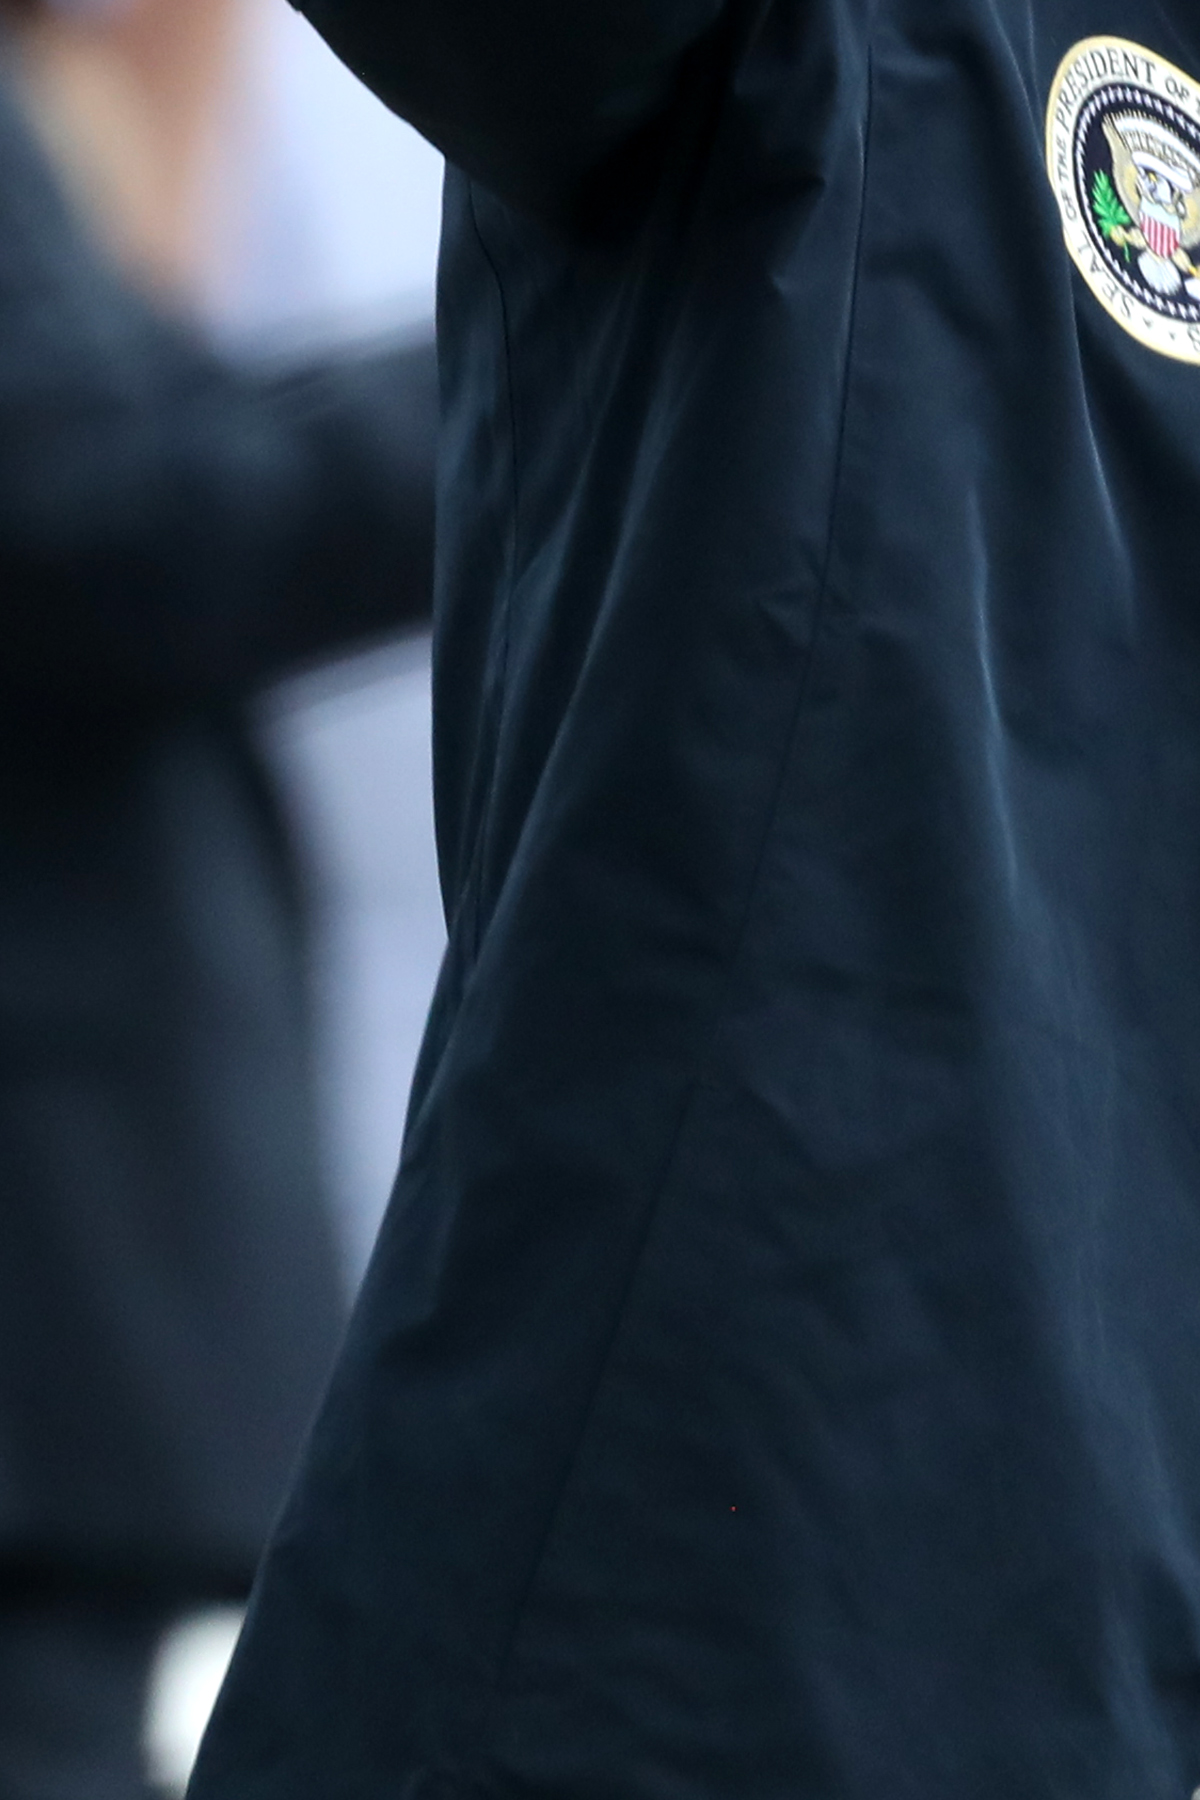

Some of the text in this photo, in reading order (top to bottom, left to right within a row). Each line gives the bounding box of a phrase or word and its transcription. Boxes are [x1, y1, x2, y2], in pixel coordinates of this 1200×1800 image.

[1056, 48, 1156, 129] PRESIDENT
[1056, 138, 1069, 181] THE
[1077, 237, 1133, 318] SEAL
